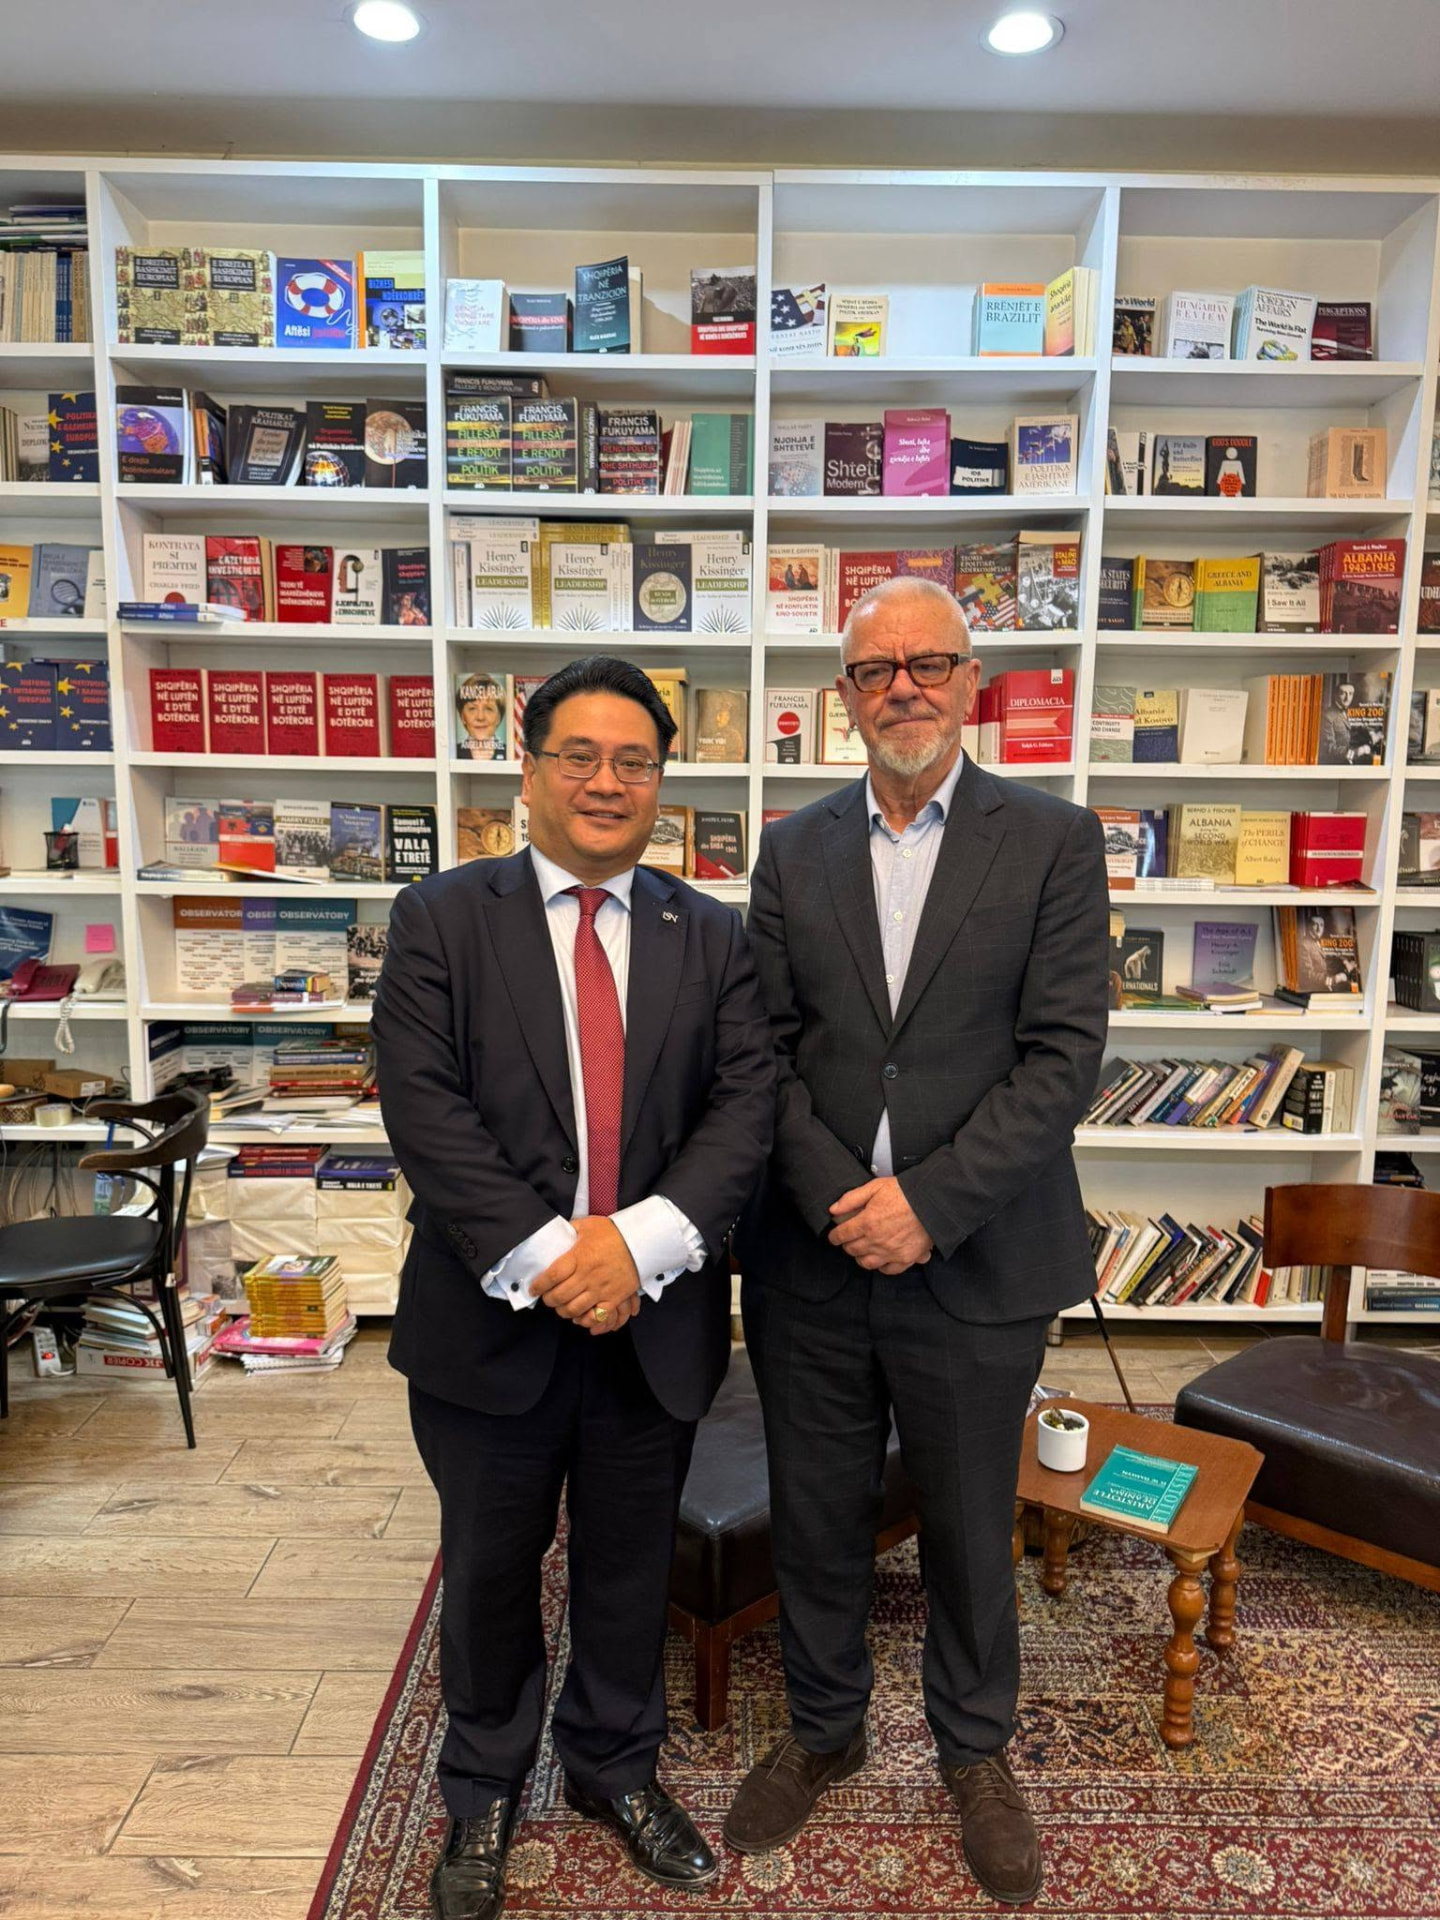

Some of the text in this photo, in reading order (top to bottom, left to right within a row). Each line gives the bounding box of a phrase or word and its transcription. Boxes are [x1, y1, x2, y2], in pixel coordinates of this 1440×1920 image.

[986, 300, 1041, 312] RRËNJËT E
[1131, 298, 1155, 307] World
[986, 312, 1040, 323] BRAZILIT
[1255, 318, 1270, 327] The
[1269, 319, 1288, 330] World
[460, 405, 498, 413] FRANCIS
[524, 405, 562, 413] FRANCIS
[455, 412, 503, 420] FUKUYAMA
[519, 413, 567, 421] FUKUYAMA
[608, 417, 648, 425] FRANCIS
[458, 430, 500, 438] FILLESAT
[523, 430, 564, 440] FILLESAT
[602, 426, 655, 435] FUKUYAMA
[774, 443, 815, 451] SHTETEVE
[467, 448, 500, 457] RENDIT
[532, 449, 565, 458] RENDIT
[462, 466, 498, 475] POLITIK
[526, 466, 562, 475] POLITIK
[827, 460, 877, 477] Shteti
[826, 478, 864, 488] Modern
[149, 540, 200, 550] KONTRATA
[170, 552, 178, 560] SI
[486, 551, 517, 561] Henry
[566, 554, 596, 563] Henry
[707, 554, 737, 563] Henry
[1344, 552, 1396, 563] ALBANIA
[152, 562, 197, 570] PREMTIM
[480, 563, 524, 573] Kissinger
[558, 566, 603, 575] Kissinger
[845, 565, 891, 575] SHQIPËRIA
[700, 566, 745, 576] Kissinger
[556, 580, 606, 588] LEADERSHIP
[846, 577, 857, 585] NË
[156, 681, 198, 690] SHQIPËRIA
[213, 683, 258, 692] SHQIPËRIA
[271, 684, 313, 694] SHQIPËRIA
[329, 685, 373, 695] SHQIPËRIA
[171, 691, 198, 701] LUFTËN
[396, 687, 434, 697] SHQIPËRI
[215, 694, 258, 703] NË LUFTËN
[272, 694, 312, 704] NË LUFTËN
[344, 697, 372, 706] LUFTËN
[411, 698, 434, 707] LUFTË
[1010, 697, 1064, 707] DIPLOMACIA
[172, 702, 192, 711] DYTË
[230, 704, 250, 713] DYTË
[287, 705, 306, 714] DYTË
[346, 707, 365, 716] DYTË
[413, 709, 432, 718] DYTË
[1348, 708, 1383, 716] KING ZOG
[158, 713, 200, 722] BOTËRORE
[215, 715, 259, 724] BOTËRORE
[273, 716, 314, 725] BOTËRORE
[330, 718, 374, 727] BOTËRORE
[398, 719, 435, 728] BOTËROR
[394, 839, 430, 850] VALA
[395, 851, 430, 863] E TRETË
[180, 910, 242, 918] OBSERVATOR
[279, 911, 349, 920] OBSERVATORY
[184, 1026, 250, 1034] OBSERVATORY
[258, 1026, 326, 1035] OBSERVATORY
[105, 1357, 144, 1366] COPIER
[1152, 1465, 1195, 1522] ARISTOTLE
